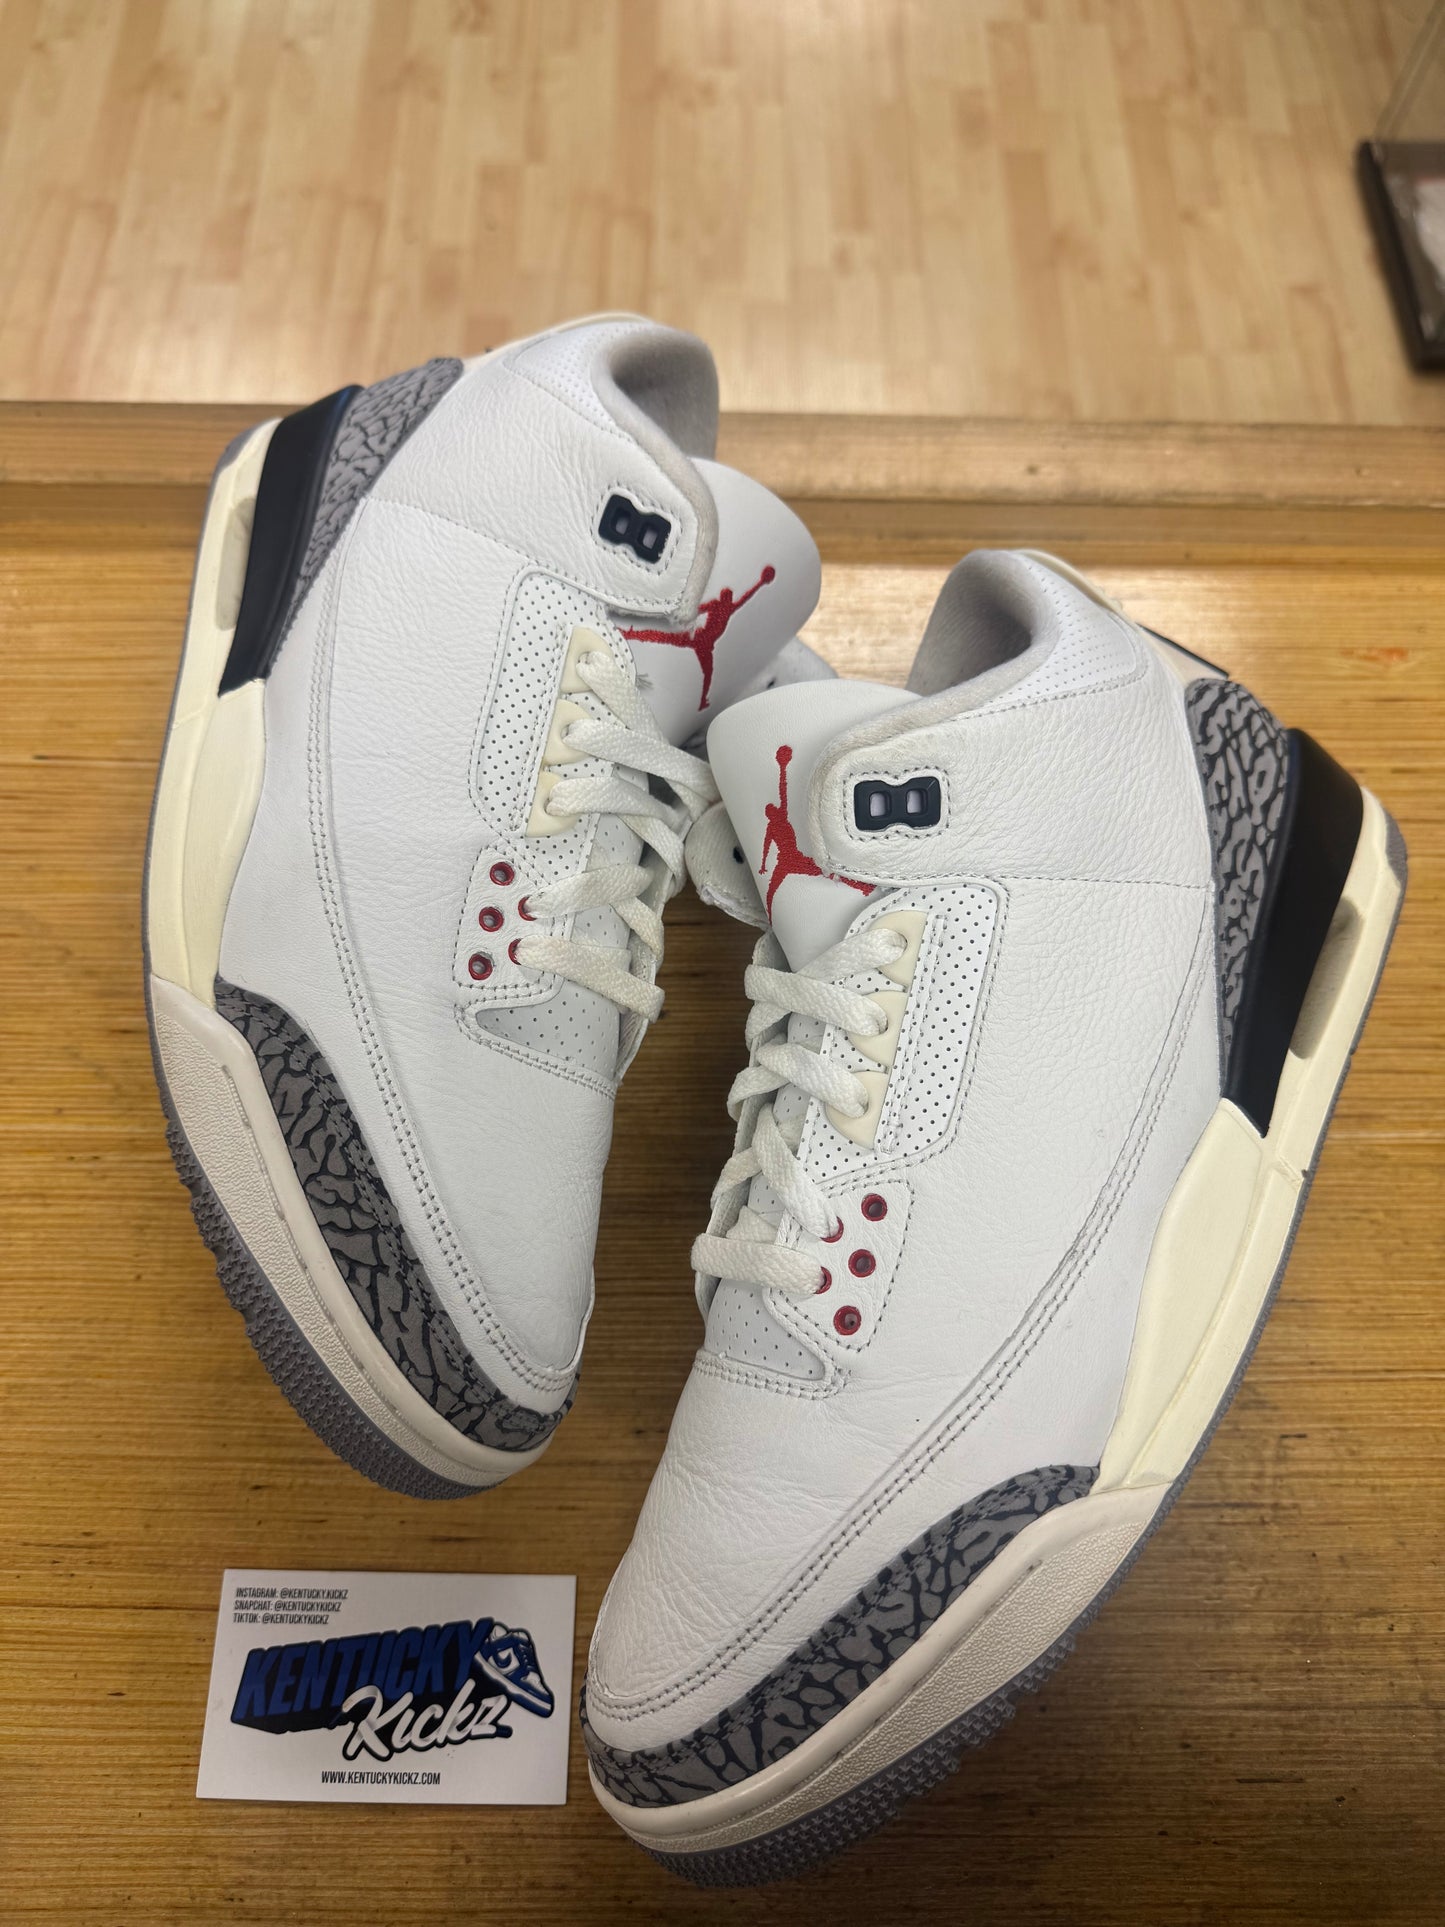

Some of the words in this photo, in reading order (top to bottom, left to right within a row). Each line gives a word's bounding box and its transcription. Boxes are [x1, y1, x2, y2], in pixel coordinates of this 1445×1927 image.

[236, 1587, 278, 1598] INSTAGRAM:
[234, 1600, 273, 1611] SNAPCHAT:
[274, 1600, 341, 1612] @KENTUCKYKICKZ
[233, 1612, 260, 1623] TIKTOK:
[262, 1612, 329, 1624] @KENTUCKYKICKZ
[232, 1618, 494, 1721] KENTUCKY
[341, 1678, 508, 1759] Kickz
[321, 1771, 441, 1785] WWW.KENTUCKYKICKZ.COM
